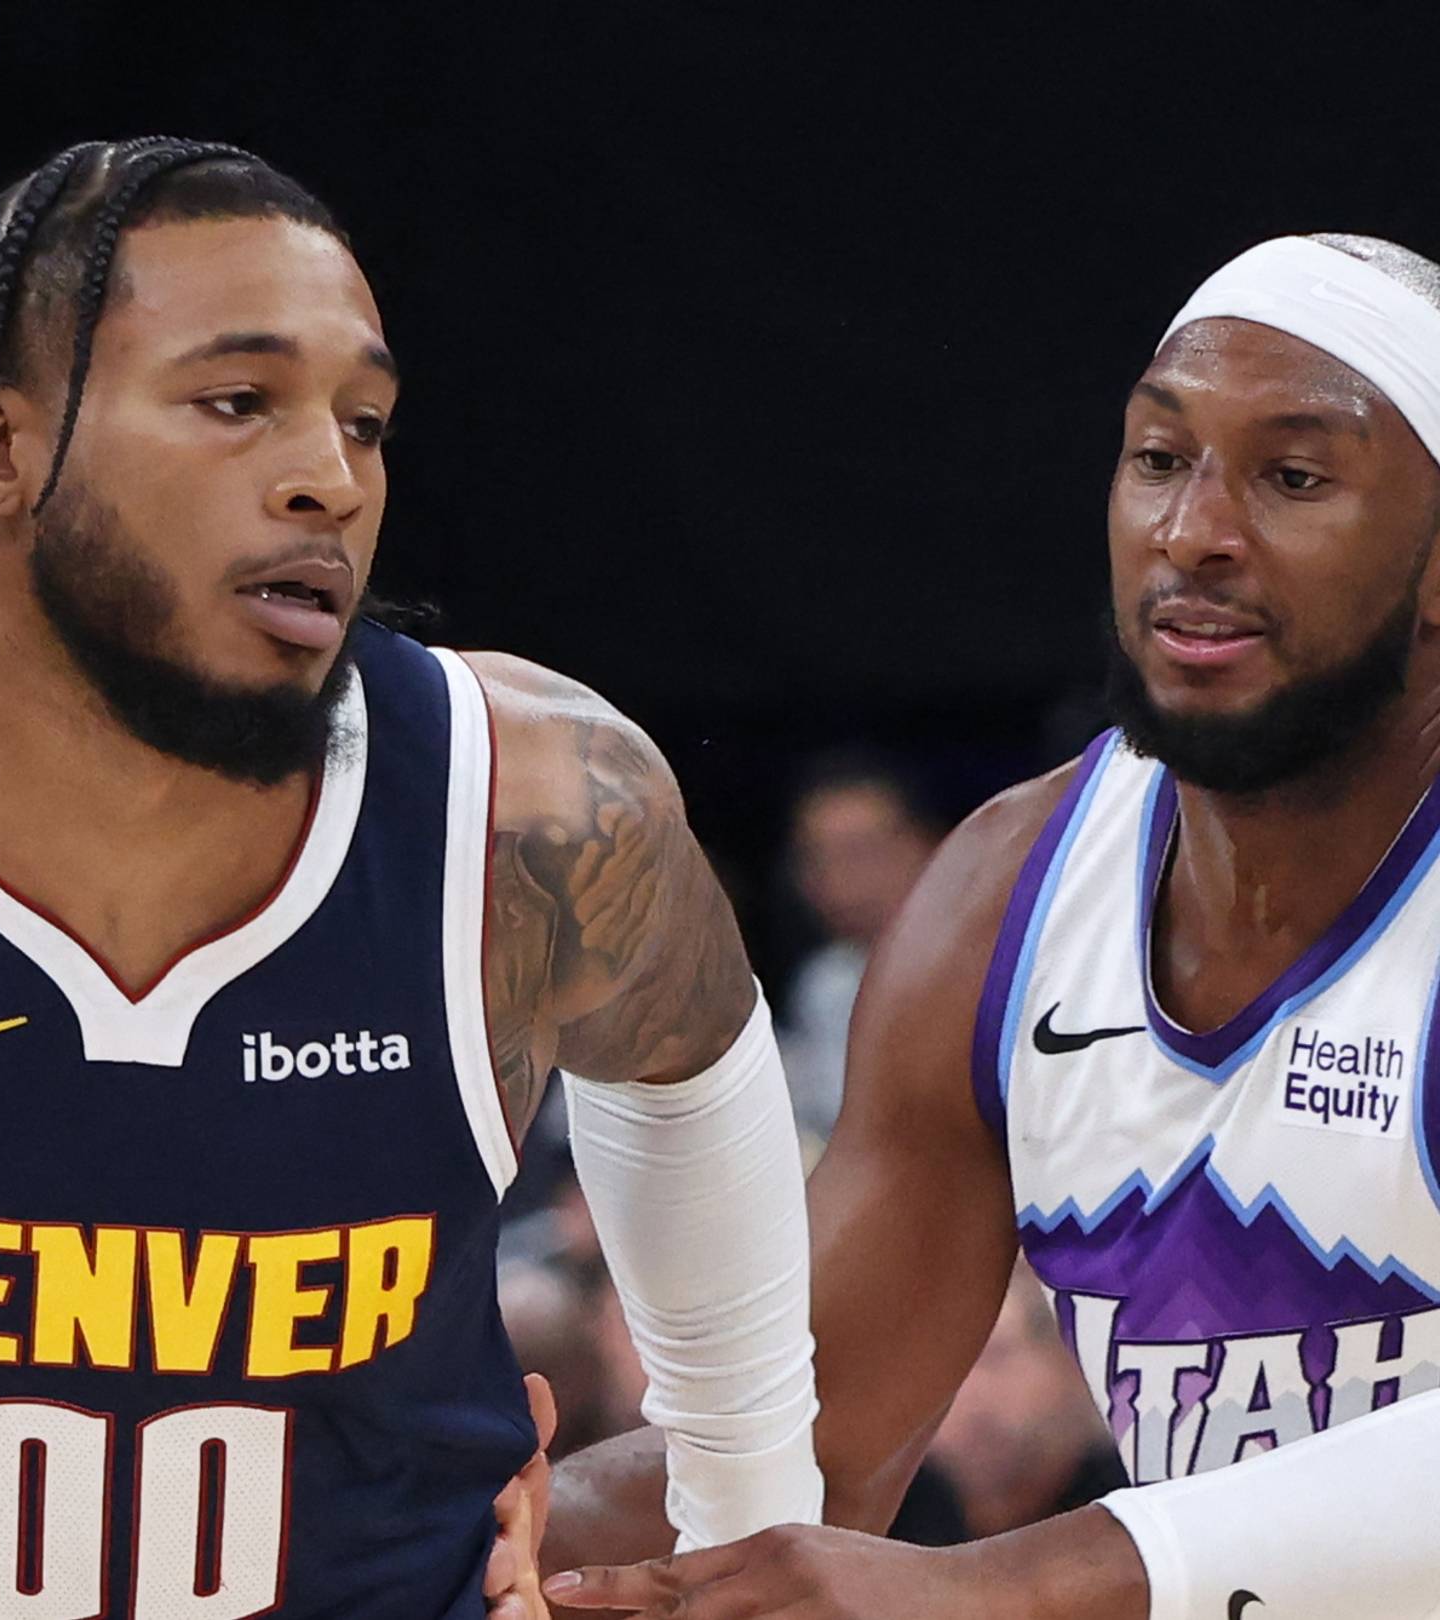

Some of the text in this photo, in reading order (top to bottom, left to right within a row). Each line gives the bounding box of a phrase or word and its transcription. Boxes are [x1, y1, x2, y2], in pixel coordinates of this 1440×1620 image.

[242, 1030, 411, 1082] ibotta
[1289, 1026, 1404, 1080] Health
[1284, 1071, 1399, 1133] Equity
